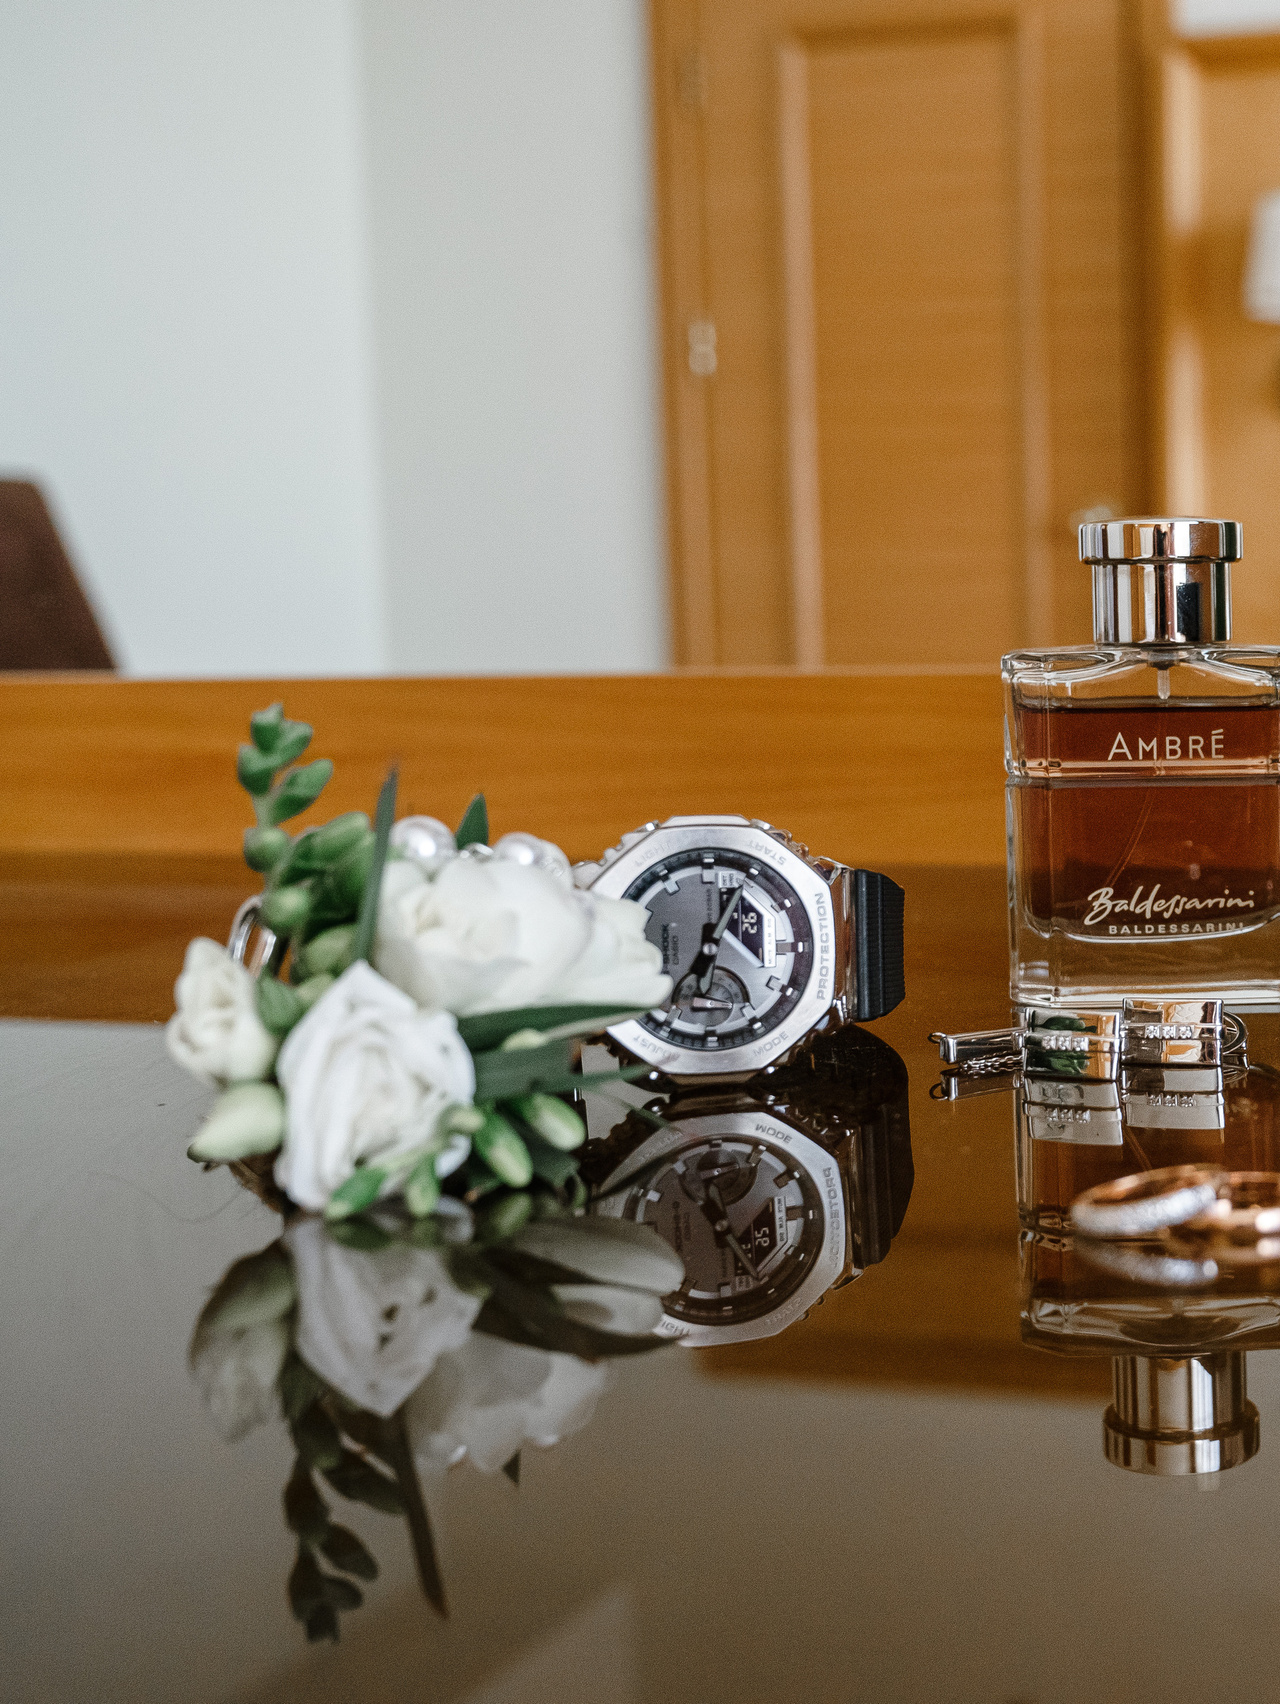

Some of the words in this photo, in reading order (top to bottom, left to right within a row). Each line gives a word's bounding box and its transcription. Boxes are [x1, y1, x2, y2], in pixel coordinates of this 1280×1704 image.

[1107, 728, 1225, 761] AMBRÉ
[747, 839, 787, 866] START
[1083, 883, 1255, 926] Baldessarini
[741, 911, 758, 934] 26
[1108, 922, 1244, 935] BALDESSARINI
[814, 892, 830, 1001] PROTECTION
[752, 1030, 790, 1058] MODE
